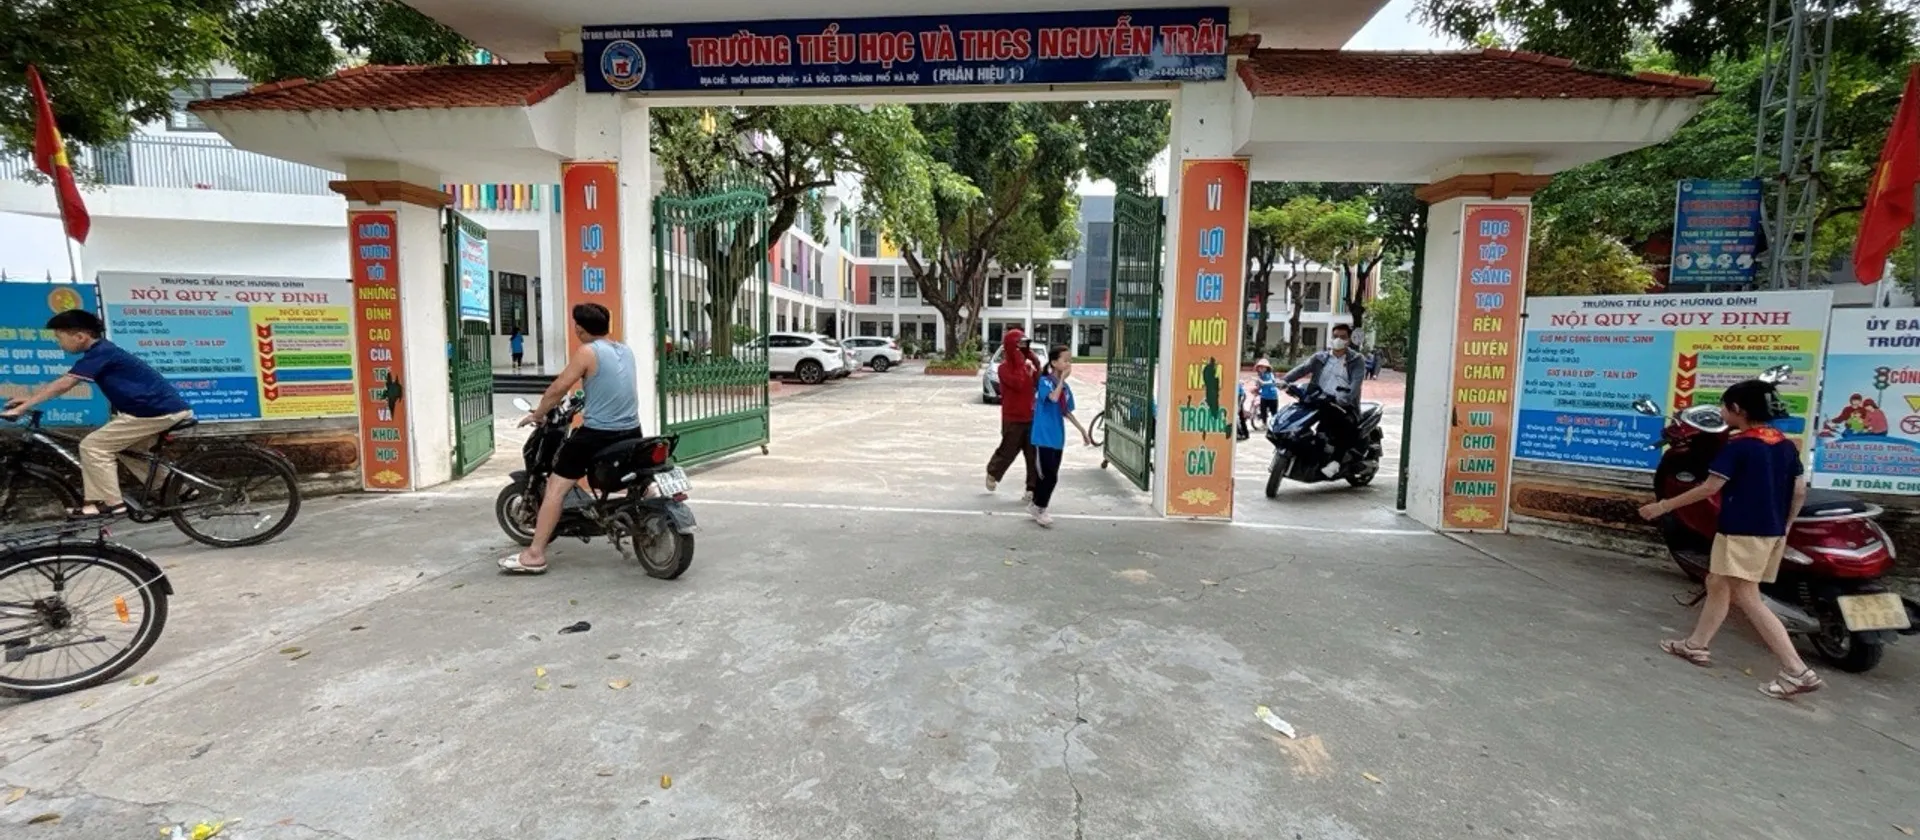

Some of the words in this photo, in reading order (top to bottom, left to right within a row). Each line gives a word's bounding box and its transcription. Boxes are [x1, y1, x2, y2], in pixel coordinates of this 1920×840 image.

[688, 29, 792, 67] TRƯỜNG
[797, 23, 856, 65] TIỂU
[859, 32, 915, 69] HỌC
[920, 25, 958, 62] VÀ
[960, 28, 1031, 61] THCS
[1038, 12, 1154, 59] NGUYỄN
[1160, 18, 1226, 56] TRÃI
[977, 64, 1004, 84] HIỆU
[584, 180, 597, 210] VÌ
[1207, 178, 1222, 211] VÌ
[359, 222, 390, 239] LUÔN
[1479, 221, 1510, 240] HỌC
[581, 224, 605, 259] LỢI
[1199, 226, 1225, 263] LỢI
[360, 244, 391, 259] VƯƠN
[1479, 242, 1508, 264] TẬP
[366, 262, 386, 280] TỚI
[582, 262, 605, 294] ÍCH
[1471, 266, 1511, 284] SÁNG
[160, 278, 200, 286] TRƯỜNG
[203, 276, 222, 286] TIỂU
[226, 279, 245, 287] HỌC
[1196, 268, 1224, 302] ÍCH
[131, 286, 168, 304] NỘI
[176, 290, 218, 301] QUY
[236, 291, 275, 302] QUY
[282, 292, 329, 306] ĐỊNH
[359, 283, 396, 300] NHỮNG
[1475, 293, 1503, 312] TẠO
[1582, 299, 1623, 308] TRƯỜNG
[1626, 297, 1650, 307] TIỂU
[1653, 299, 1676, 308] HỌC
[1681, 297, 1723, 306] HƯƠNG
[1472, 315, 1502, 332] RÈN
[1551, 310, 1588, 329] NỘI
[1594, 313, 1642, 326] QUY
[1661, 312, 1714, 326] QUY
[1720, 312, 1791, 329] ĐỊNH
[1866, 316, 1890, 330] ỦY
[368, 328, 391, 341] CAO
[1188, 312, 1228, 346] MƯỜI
[1746, 334, 1782, 343] QUY
[1463, 339, 1508, 359] LUYỆN
[1464, 362, 1505, 379] CHĂM
[1456, 388, 1508, 404] NGOAN
[1468, 411, 1493, 427] VUI
[370, 428, 401, 442] KHOA
[1462, 434, 1496, 449] CHƠI
[376, 448, 398, 464] HỌC
[1186, 446, 1216, 476] CÂY
[1458, 455, 1496, 473] LÀNH
[1453, 481, 1496, 498] MẠNH
[1832, 479, 1851, 487] AN
[1856, 479, 1892, 489] TOÀN
